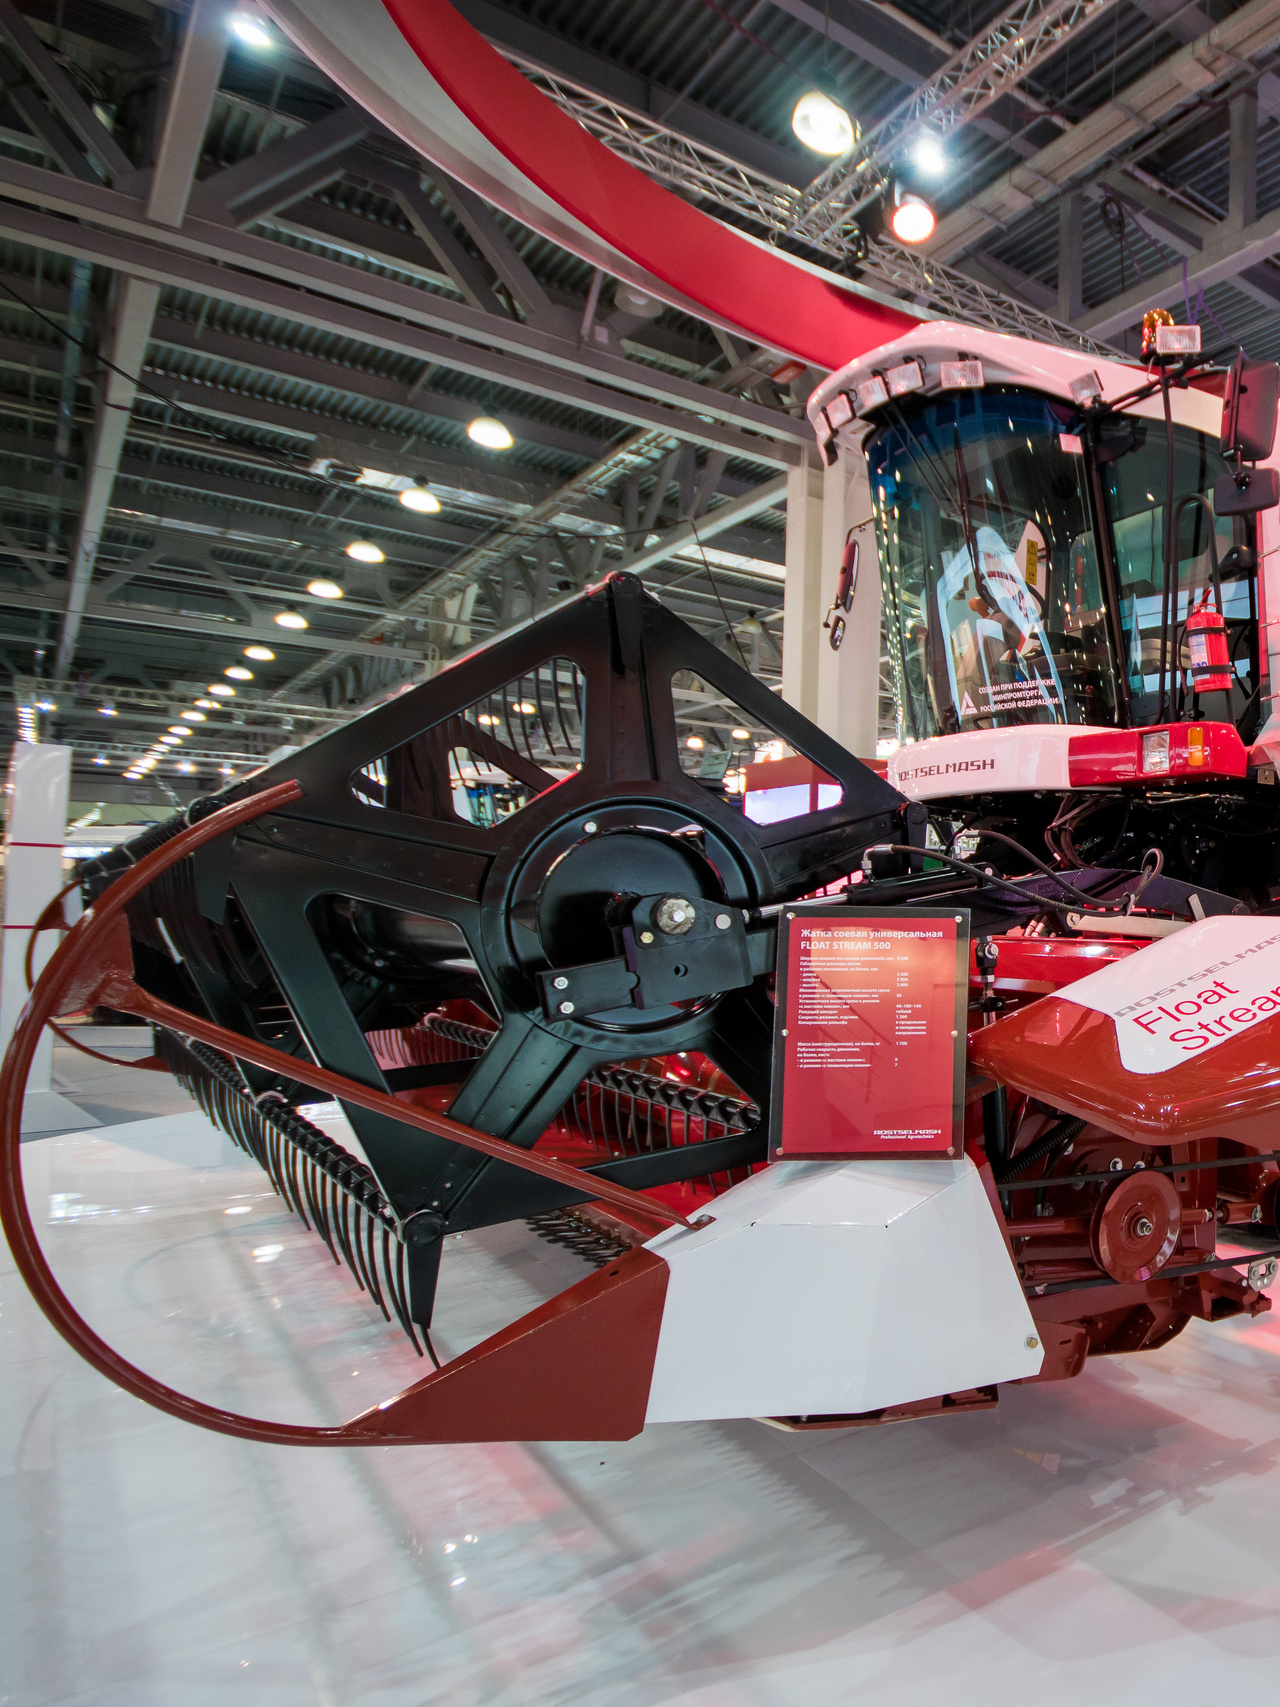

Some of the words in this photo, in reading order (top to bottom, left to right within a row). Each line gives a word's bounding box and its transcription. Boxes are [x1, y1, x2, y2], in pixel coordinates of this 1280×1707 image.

[978, 685, 1001, 694] СОЗДАН
[1014, 678, 1056, 689] ПОДДЕРЖКЕ
[992, 689, 1044, 701] МИНПРОМТОРГА
[980, 701, 1017, 713] РОССИЙСКОЙ
[1017, 698, 1058, 708] ФЕДЕРАЦИИ
[801, 929, 832, 938] Жатка
[833, 930, 867, 938] соевая
[869, 930, 943, 939] универсальная
[801, 941, 831, 950] FLOAT
[832, 941, 872, 950] STREAM
[873, 941, 891, 950] 500
[1131, 979, 1240, 1035] Float
